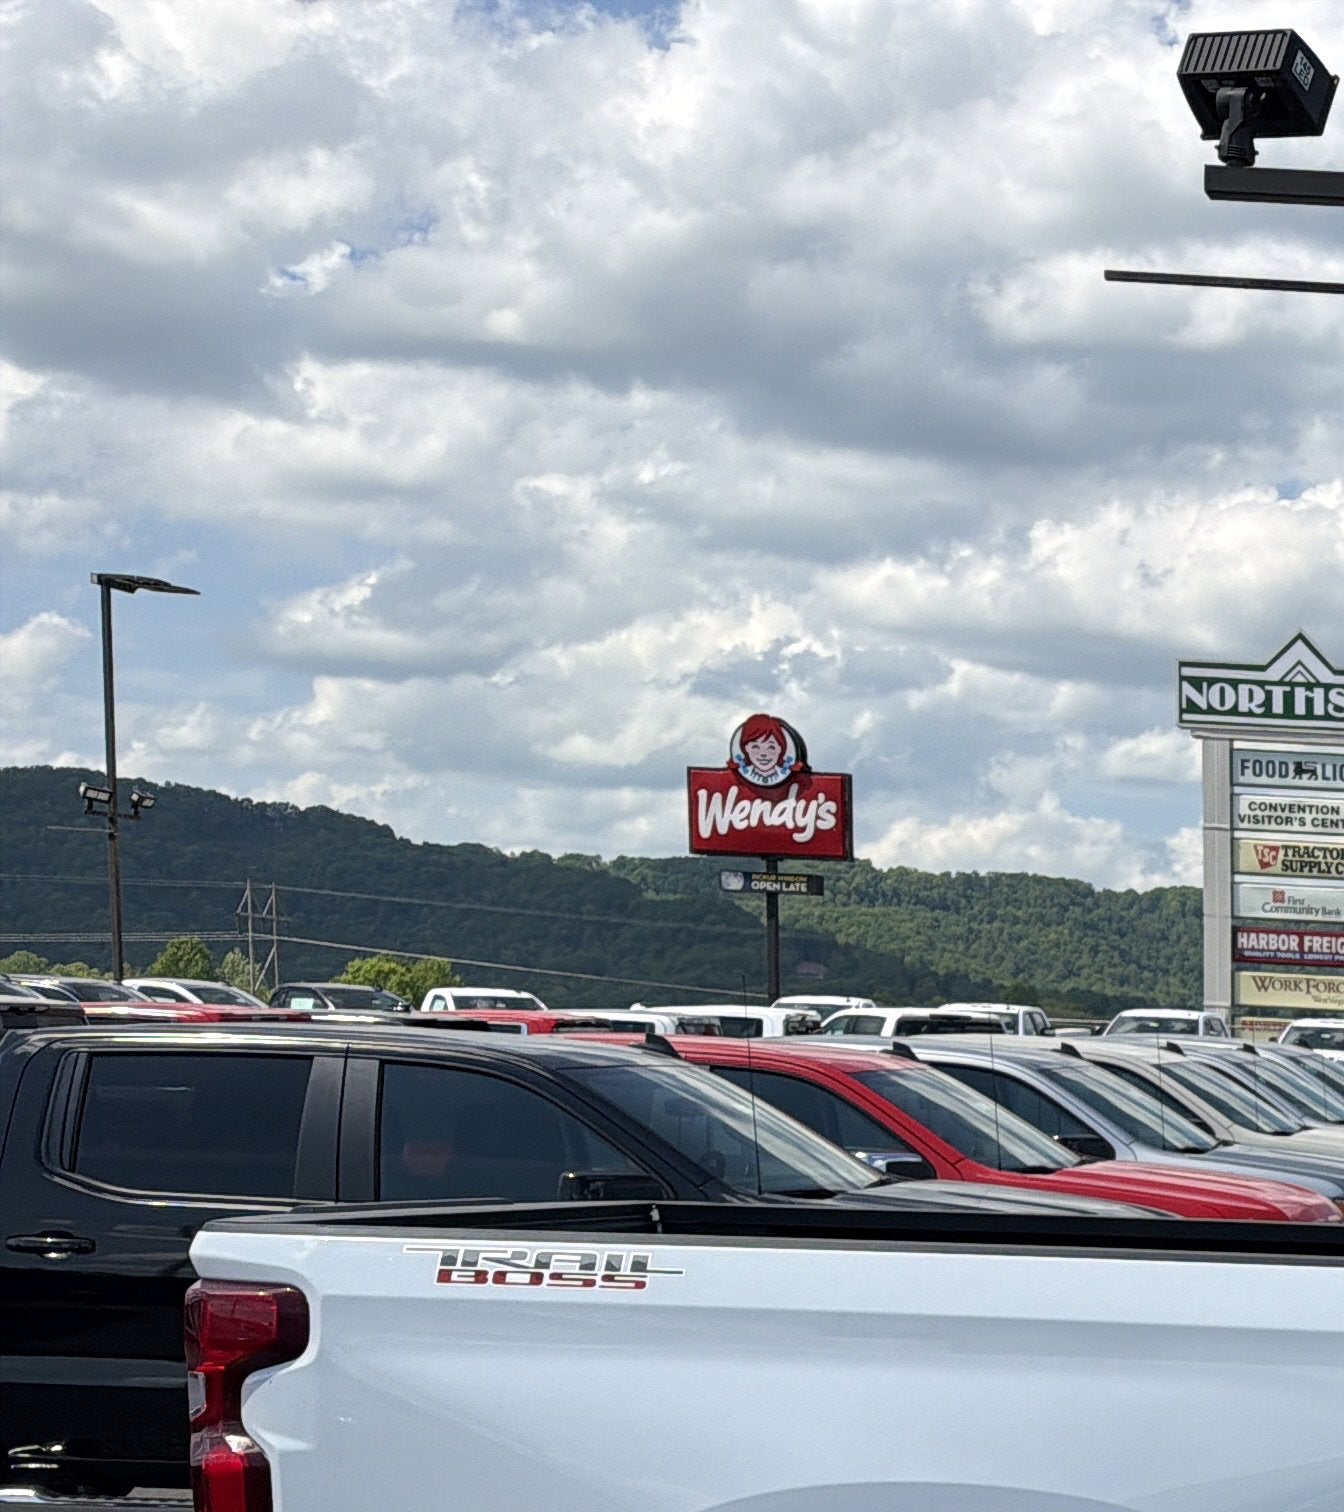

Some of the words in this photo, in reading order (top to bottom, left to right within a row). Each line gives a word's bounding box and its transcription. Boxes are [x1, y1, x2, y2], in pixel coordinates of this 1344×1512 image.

[1240, 758, 1290, 779] FOOD
[696, 783, 838, 843] Wendy's
[1247, 801, 1340, 816] CONVENTION
[1238, 813, 1307, 827] VISITOR'S
[1256, 845, 1278, 866] TSC
[1280, 858, 1333, 875] SUPPLY
[751, 880, 780, 891] OPEN
[782, 882, 808, 893] LATE
[1261, 901, 1320, 917] Community
[1321, 905, 1342, 918] Bank
[1237, 931, 1299, 951] HARBOR
[403, 1245, 685, 1276] TRAIL
[434, 1268, 648, 1291] BOSS
